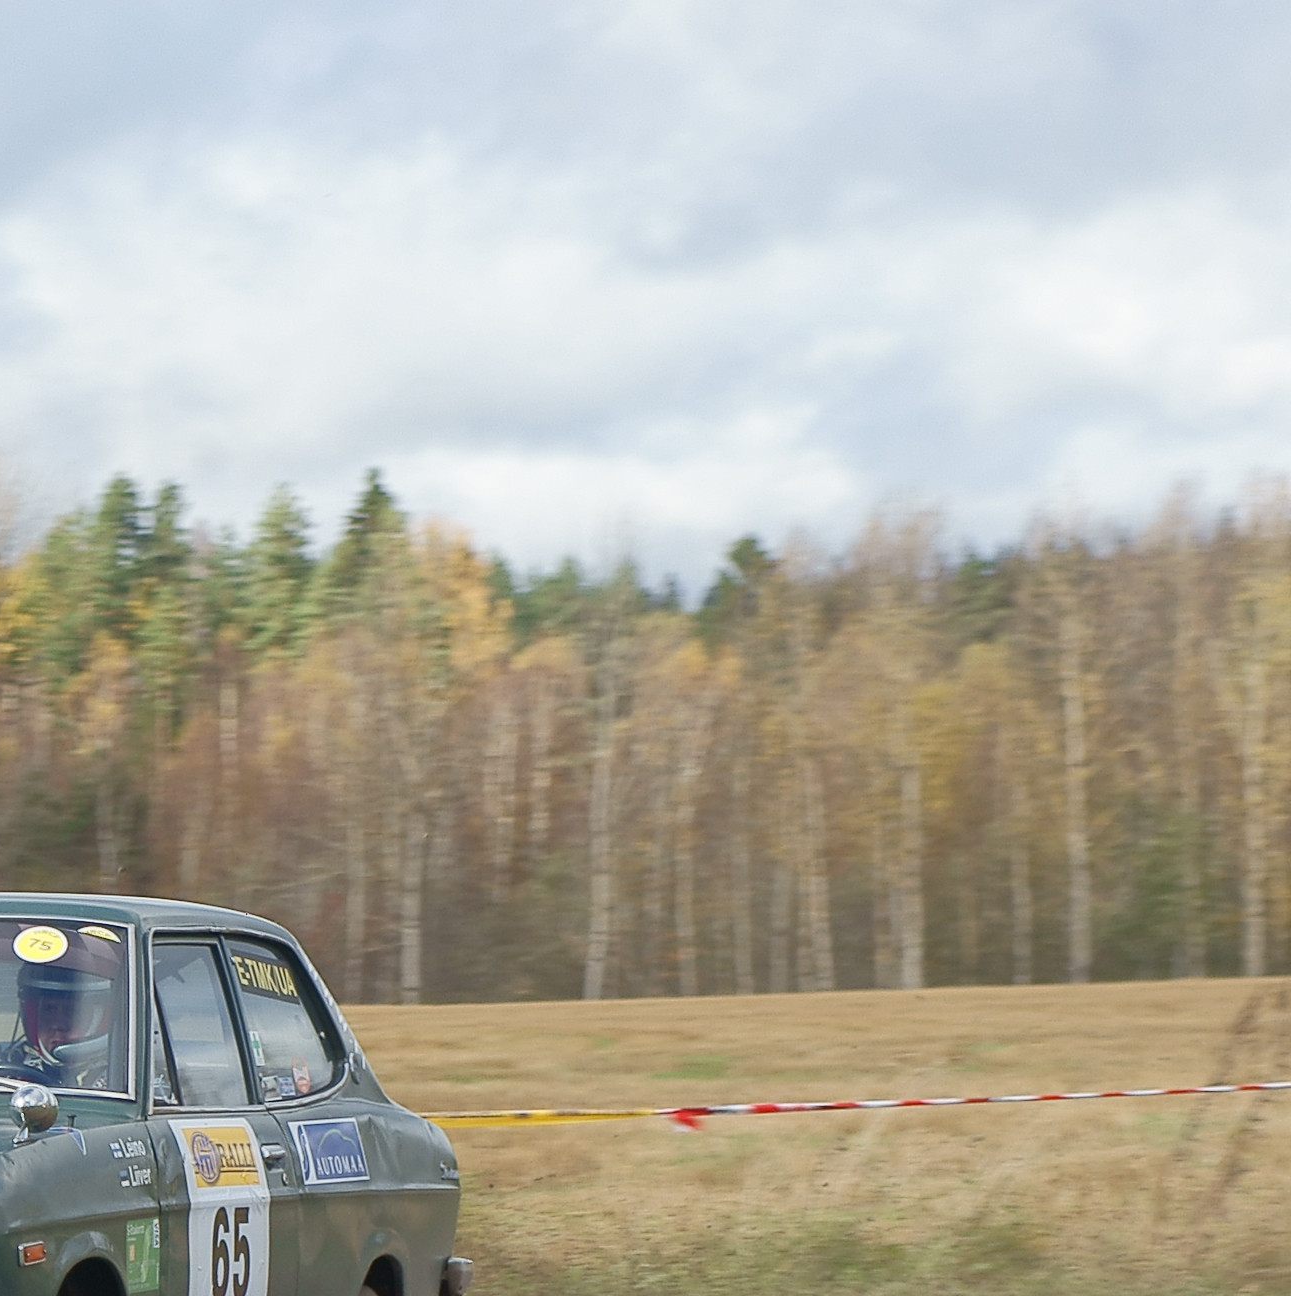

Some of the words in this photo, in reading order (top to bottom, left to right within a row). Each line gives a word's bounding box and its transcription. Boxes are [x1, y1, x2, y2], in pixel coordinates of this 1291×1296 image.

[29, 938, 53, 951] 75
[215, 1143, 257, 1168] RALLI
[316, 1154, 365, 1176] AUTOMAA
